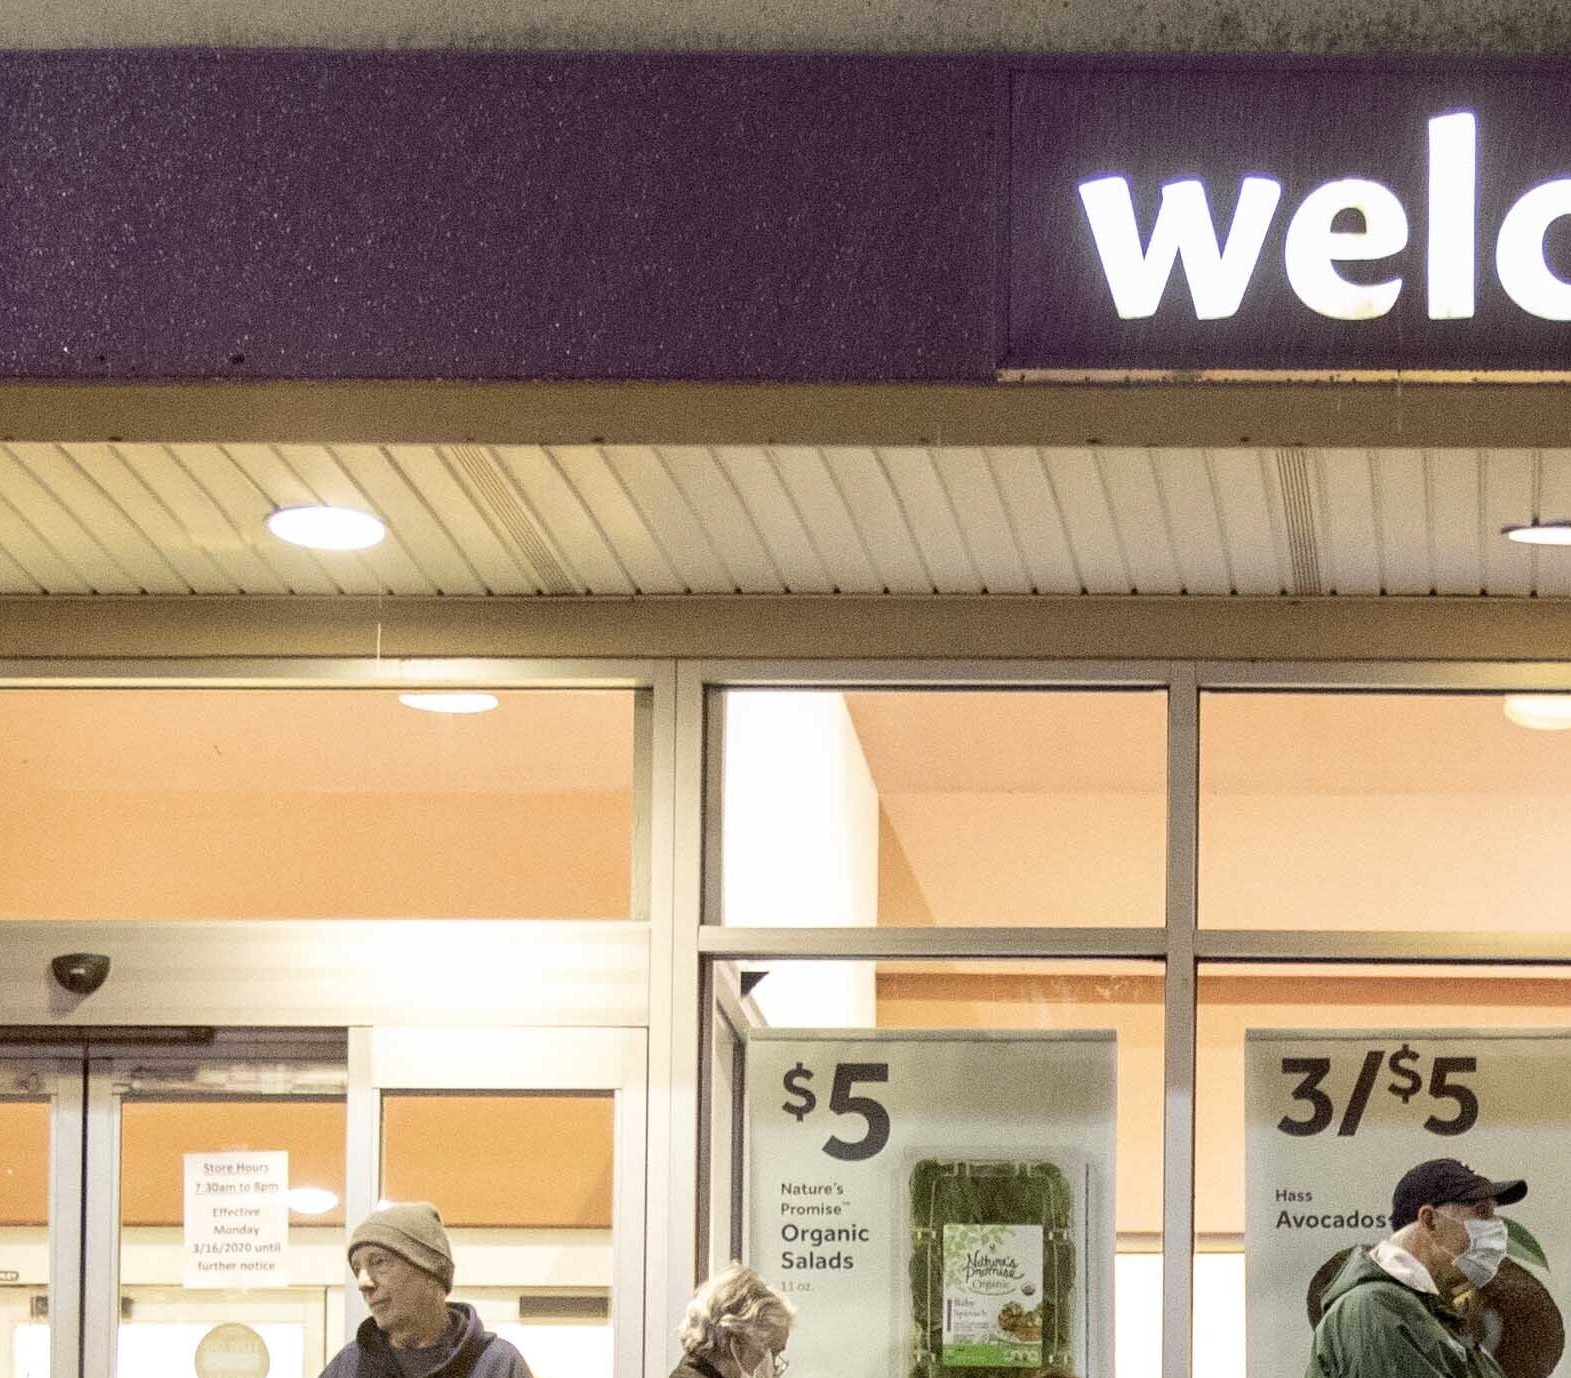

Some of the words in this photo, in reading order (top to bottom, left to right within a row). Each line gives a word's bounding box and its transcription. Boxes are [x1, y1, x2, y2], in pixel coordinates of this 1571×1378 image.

[1277, 1044, 1479, 1136] 3/$5
[781, 1062, 891, 1162] $5
[203, 1163, 233, 1173] Store
[237, 1162, 269, 1172] Hours
[239, 1183, 251, 1193] to
[781, 1182, 844, 1195] Nature's
[1276, 1189, 1313, 1202] Hass
[212, 1208, 260, 1217] Effective
[1276, 1210, 1387, 1228] Avocados
[213, 1225, 260, 1236] Monday
[781, 1224, 870, 1247] Organic
[193, 1243, 252, 1254] 3/16/2020
[254, 1242, 281, 1253] until
[197, 1261, 237, 1271] further
[240, 1261, 276, 1271] notice
[781, 1251, 854, 1270] Salads
